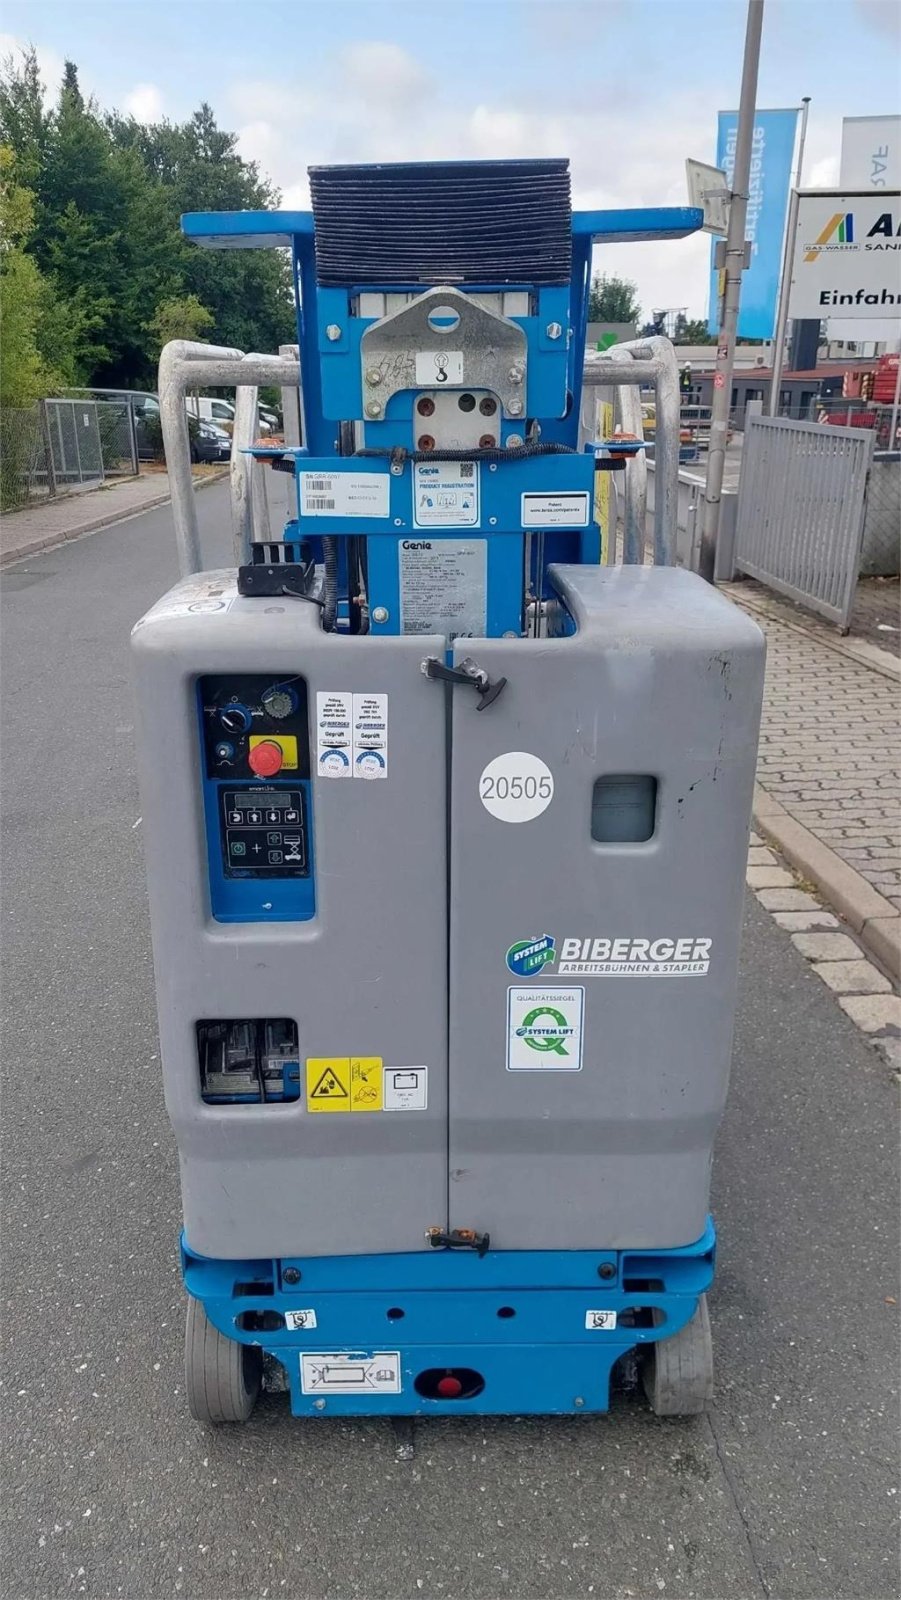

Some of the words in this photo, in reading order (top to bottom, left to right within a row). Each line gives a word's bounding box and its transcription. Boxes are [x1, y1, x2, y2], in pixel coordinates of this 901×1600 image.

[866, 213, 901, 237] A
[402, 540, 432, 550] Genie
[482, 776, 552, 800] 20505
[513, 940, 548, 962] SYSTEM
[560, 938, 713, 961] BIBERGER
[530, 952, 548, 966] LIFT
[562, 963, 650, 973] ARBEITSBÜHNEN
[652, 963, 661, 972] &
[662, 963, 706, 972] STAPLER
[516, 994, 576, 1002] QUALITÄTSSIEGEL
